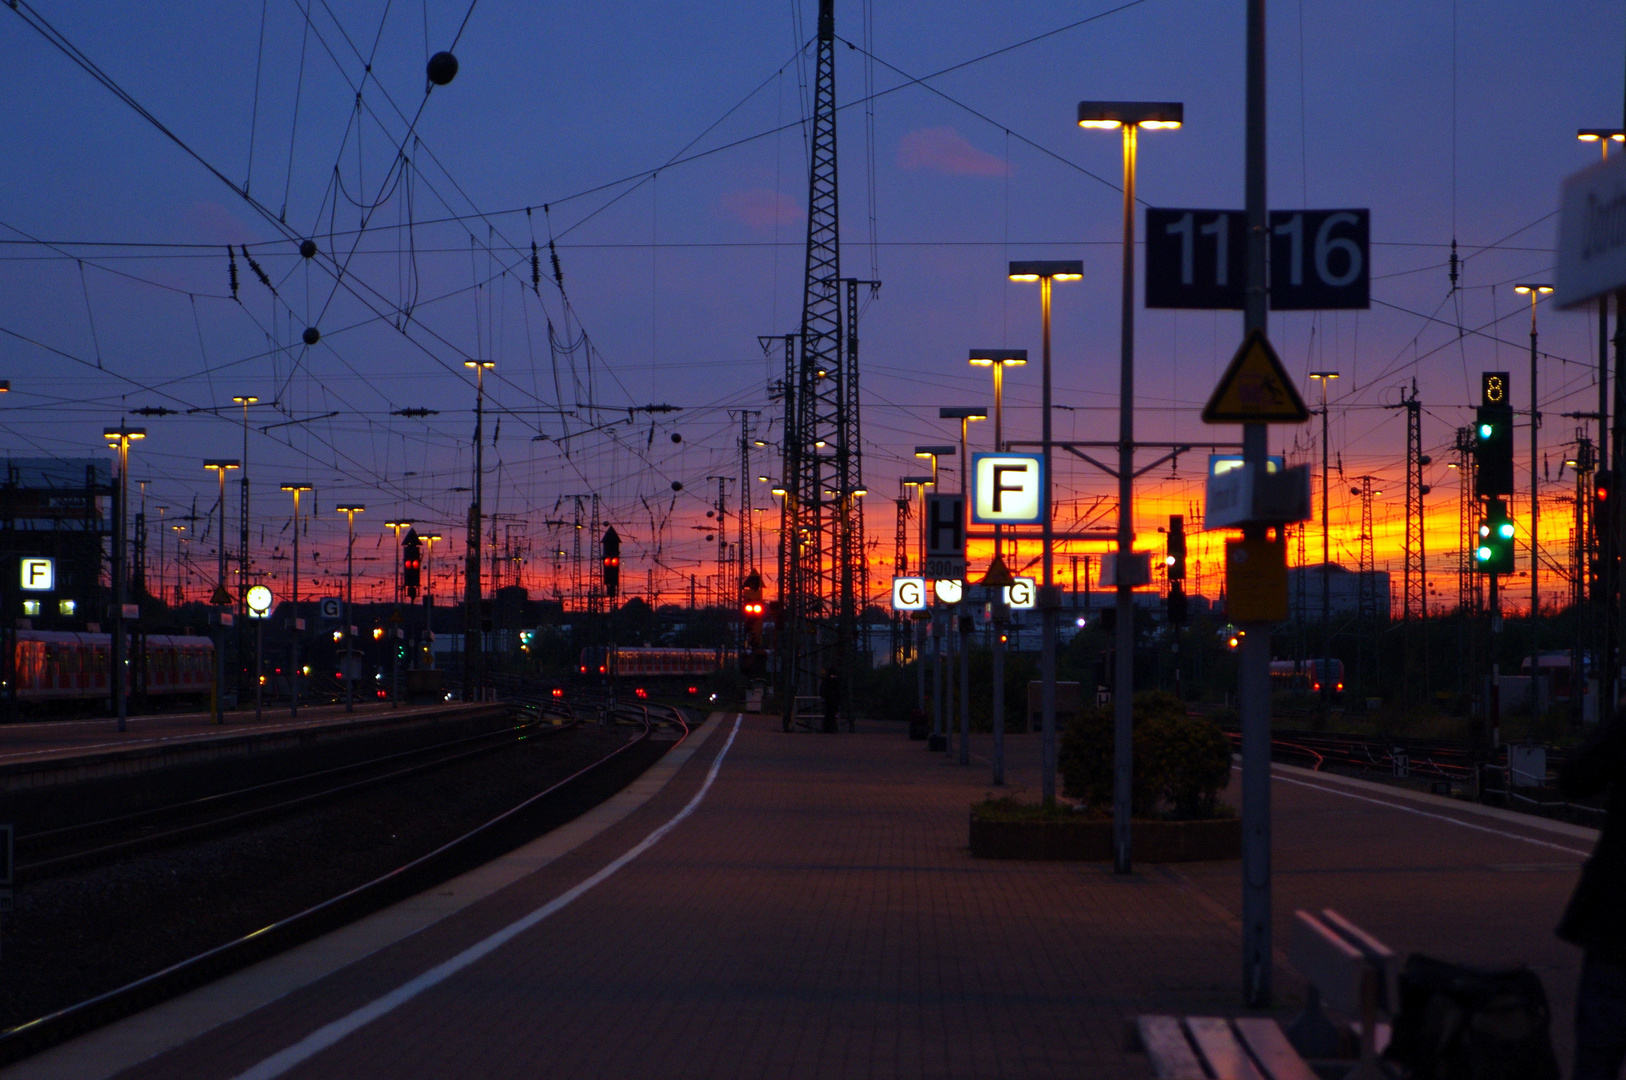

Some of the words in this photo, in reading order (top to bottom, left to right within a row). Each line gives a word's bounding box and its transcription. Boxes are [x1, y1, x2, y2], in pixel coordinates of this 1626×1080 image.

[1166, 212, 1230, 286] 11
[1276, 213, 1363, 287] 16
[1487, 377, 1503, 400] 8
[992, 464, 1028, 512] F
[931, 500, 963, 550] H
[29, 562, 46, 584] F
[899, 582, 920, 605] G
[1009, 581, 1030, 605] G
[324, 600, 338, 616] G
